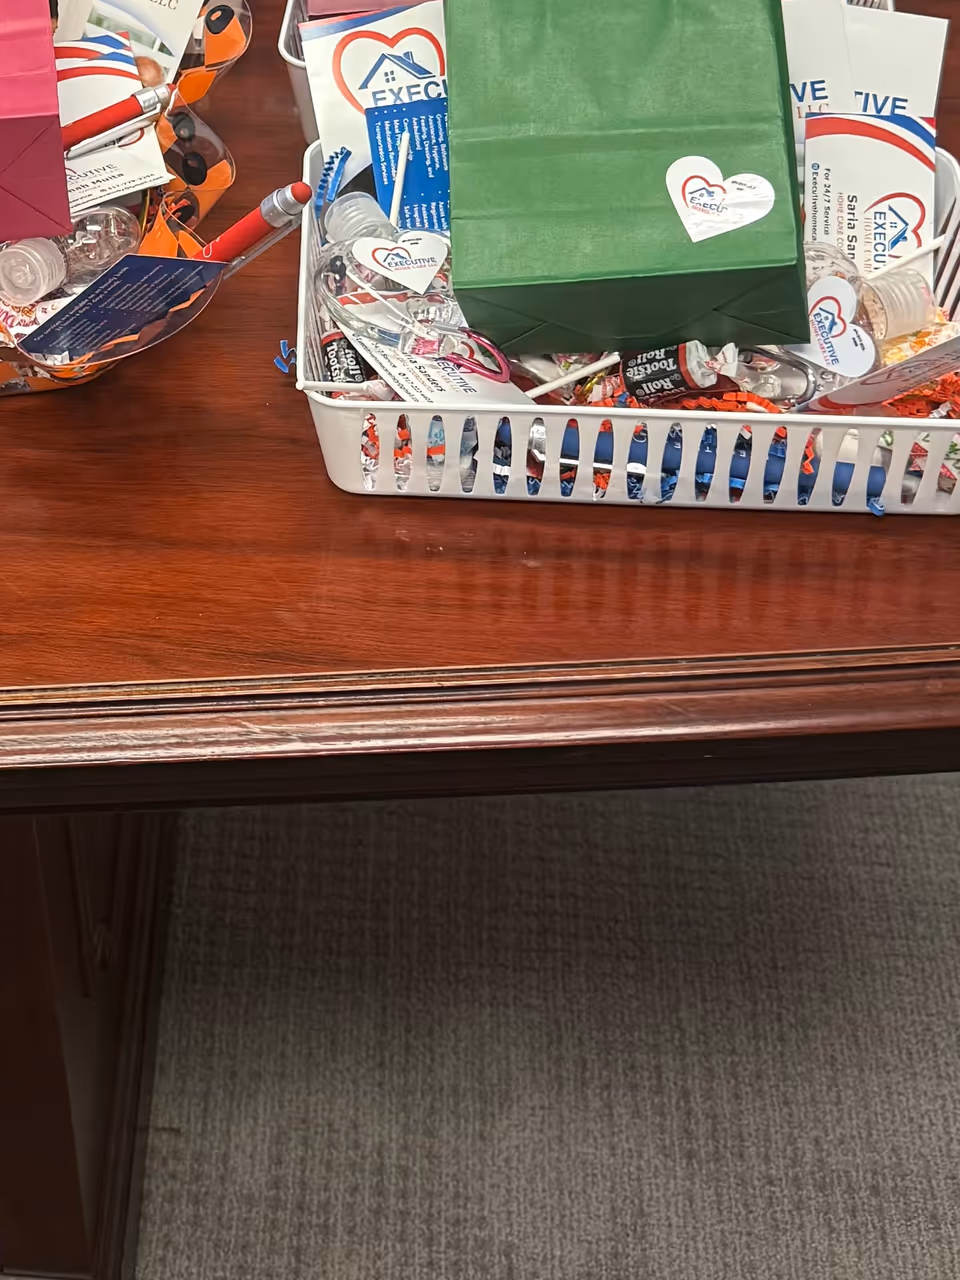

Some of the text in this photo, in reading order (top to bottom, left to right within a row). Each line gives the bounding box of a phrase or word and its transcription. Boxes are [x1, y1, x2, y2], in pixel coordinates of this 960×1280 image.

[69, 164, 117, 181] CUTIVE
[823, 183, 831, 202] 24/7
[847, 194, 859, 230] Saria
[873, 211, 886, 270] EXECU
[387, 257, 437, 268] EXECUTIVE
[813, 312, 839, 365] EXECUTIVE
[637, 348, 666, 365] Roll
[626, 358, 678, 378] Tootsie
[641, 377, 675, 393] Roll
